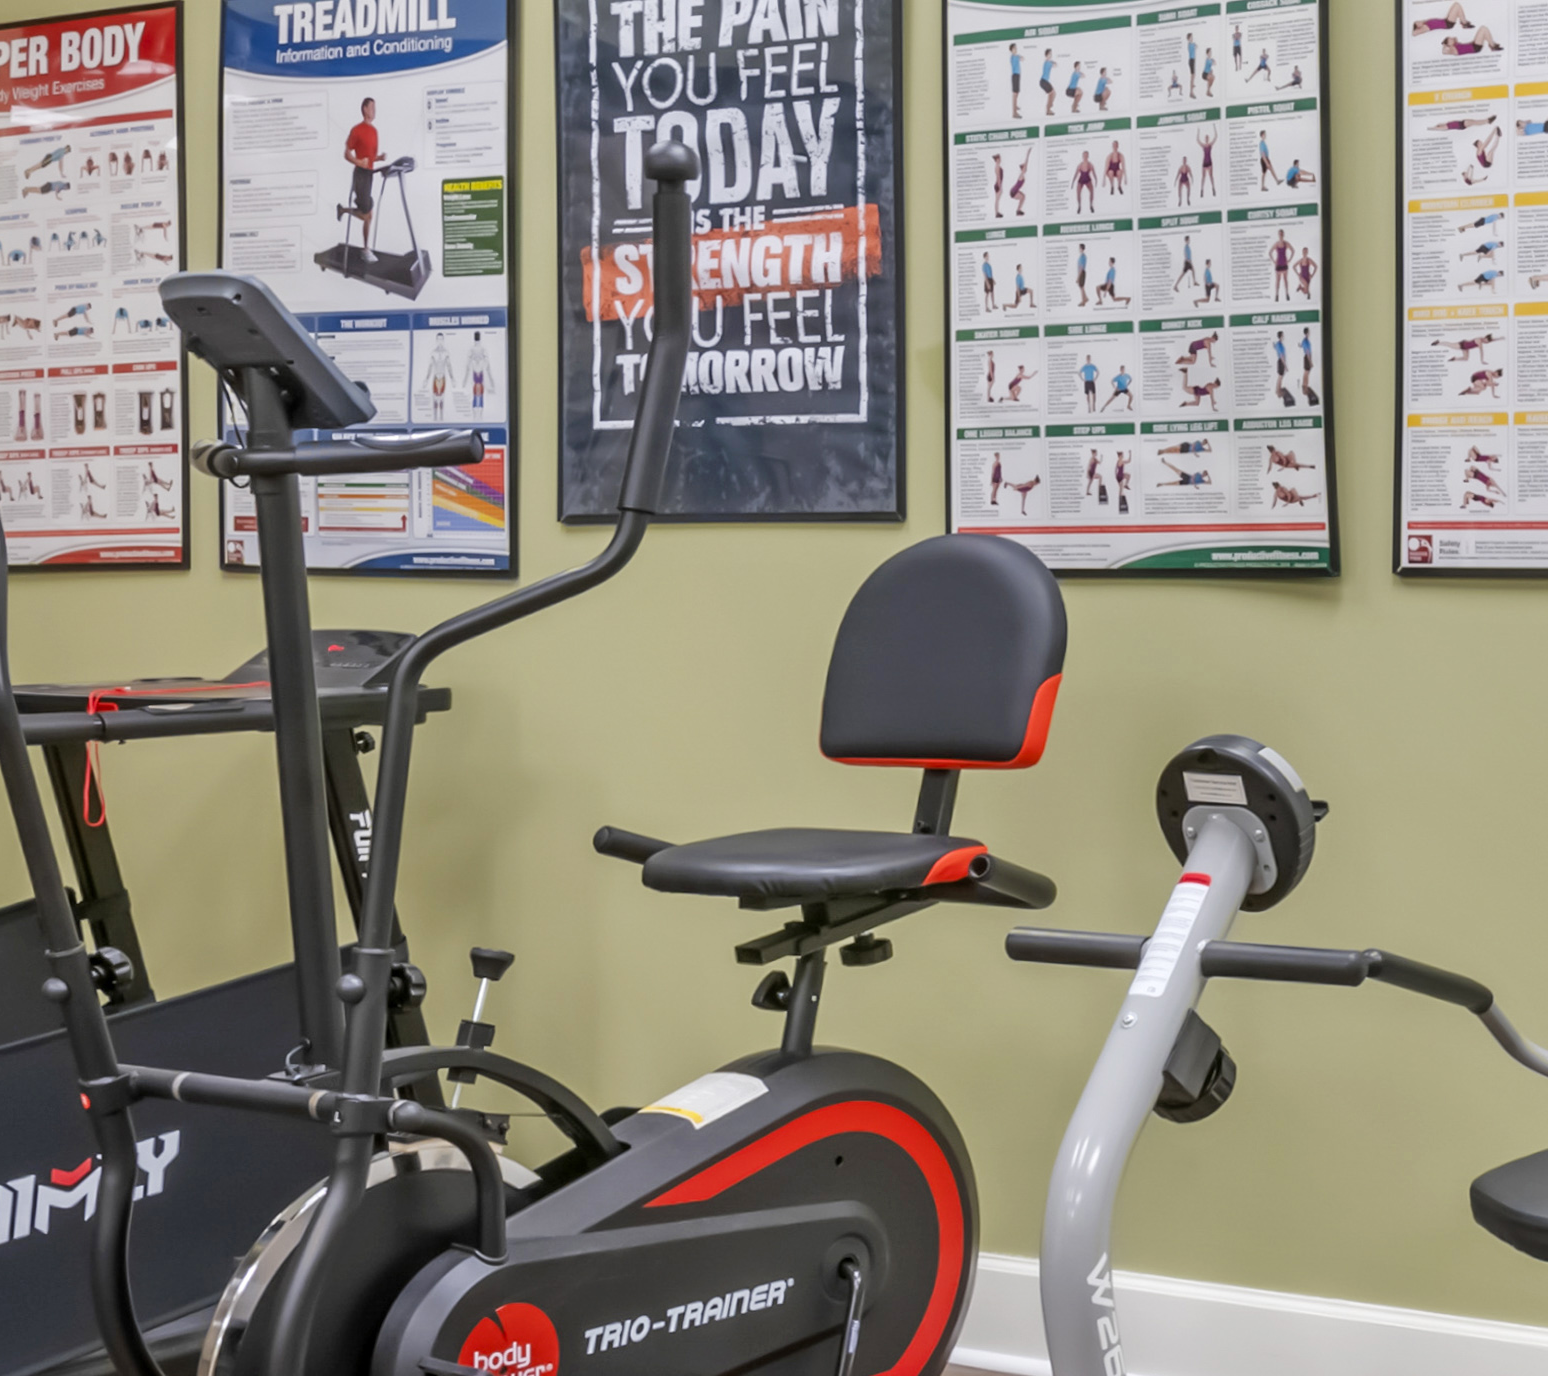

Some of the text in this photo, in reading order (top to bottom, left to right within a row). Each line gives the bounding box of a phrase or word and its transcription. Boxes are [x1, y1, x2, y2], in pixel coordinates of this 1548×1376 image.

[61, 21, 146, 72] BODY
[276, 35, 452, 64] Information and Conditioning
[12, 83, 49, 102] Weight
[52, 78, 105, 95] Exercises
[611, 41, 839, 112] YOU FEEL
[719, 205, 766, 232] THE
[614, 232, 843, 295] STENGTH
[743, 289, 845, 346] FEEL
[616, 346, 845, 396] TMORROW
[584, 1279, 786, 1355] TRIO-TRAINER
[474, 1342, 531, 1371] body
